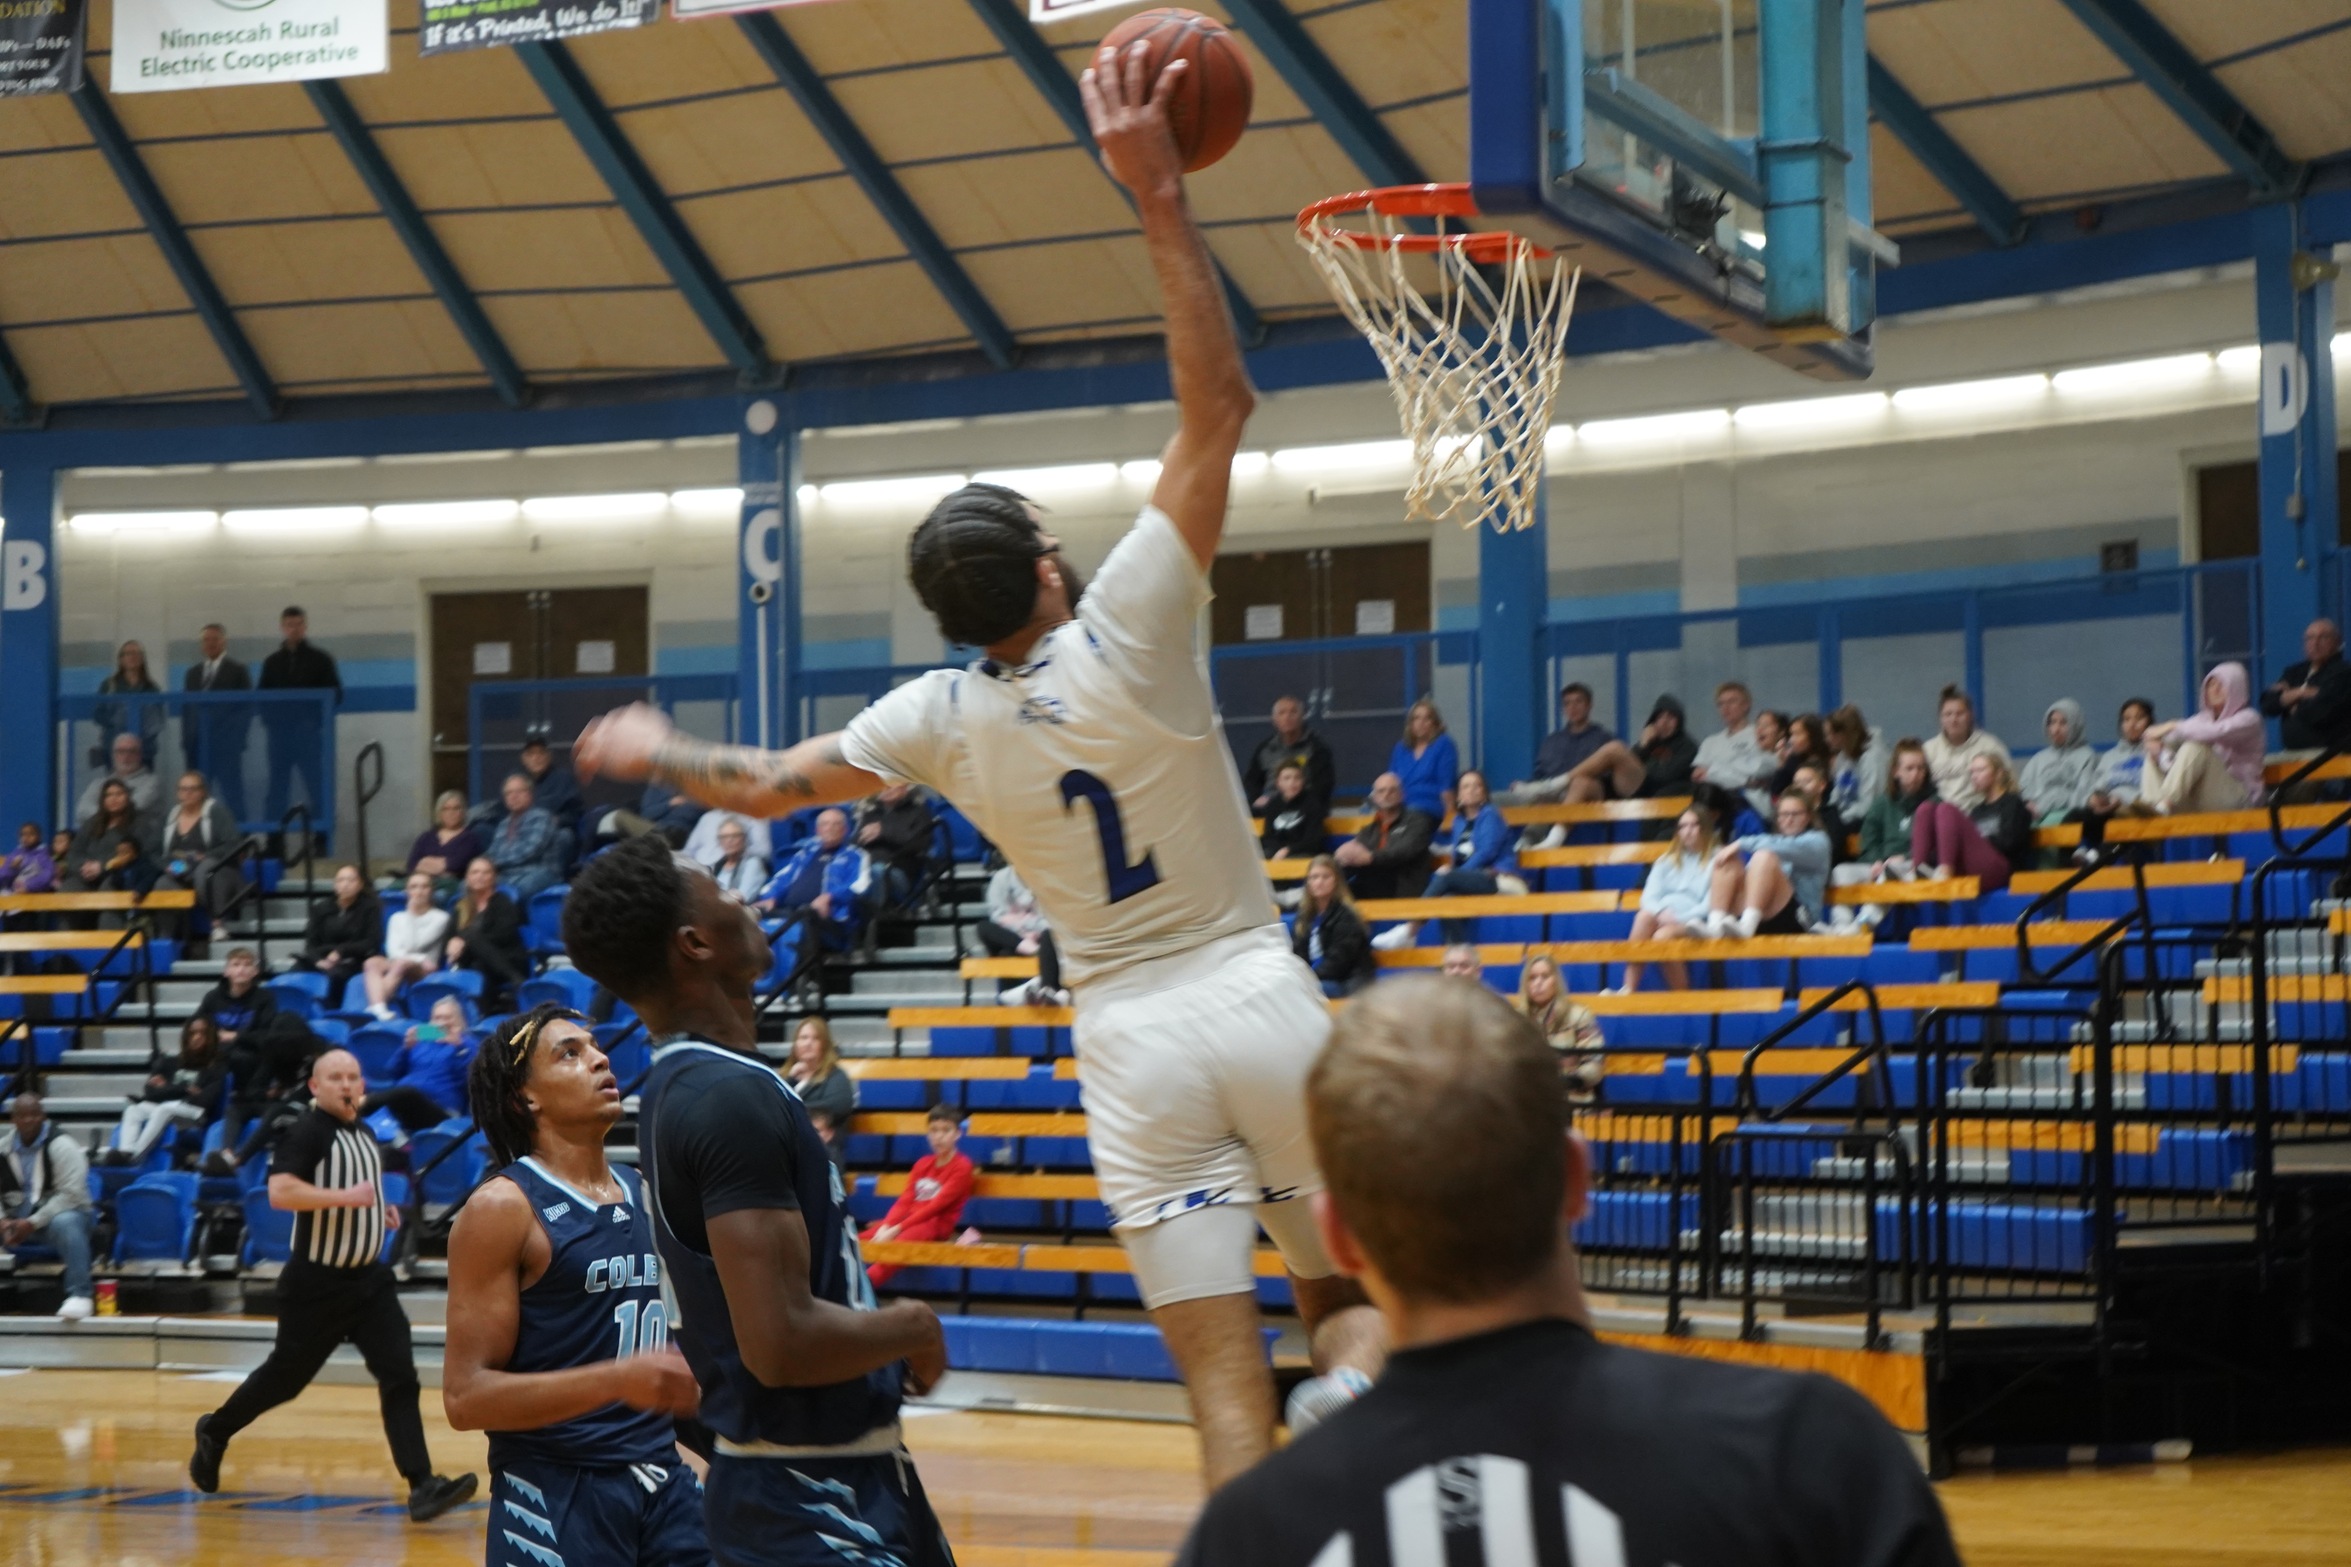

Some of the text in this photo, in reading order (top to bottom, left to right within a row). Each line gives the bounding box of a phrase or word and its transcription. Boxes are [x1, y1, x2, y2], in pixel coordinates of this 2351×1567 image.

[160, 16, 339, 50] Ninnescah Rural
[555, 4, 588, 27] We
[591, 0, 618, 22] do
[141, 43, 359, 77] Electric Cooperative
[2261, 342, 2309, 436] D
[3, 540, 46, 611] B
[744, 508, 783, 582] C
[1059, 768, 1163, 905] 2
[614, 1299, 667, 1364] 10
